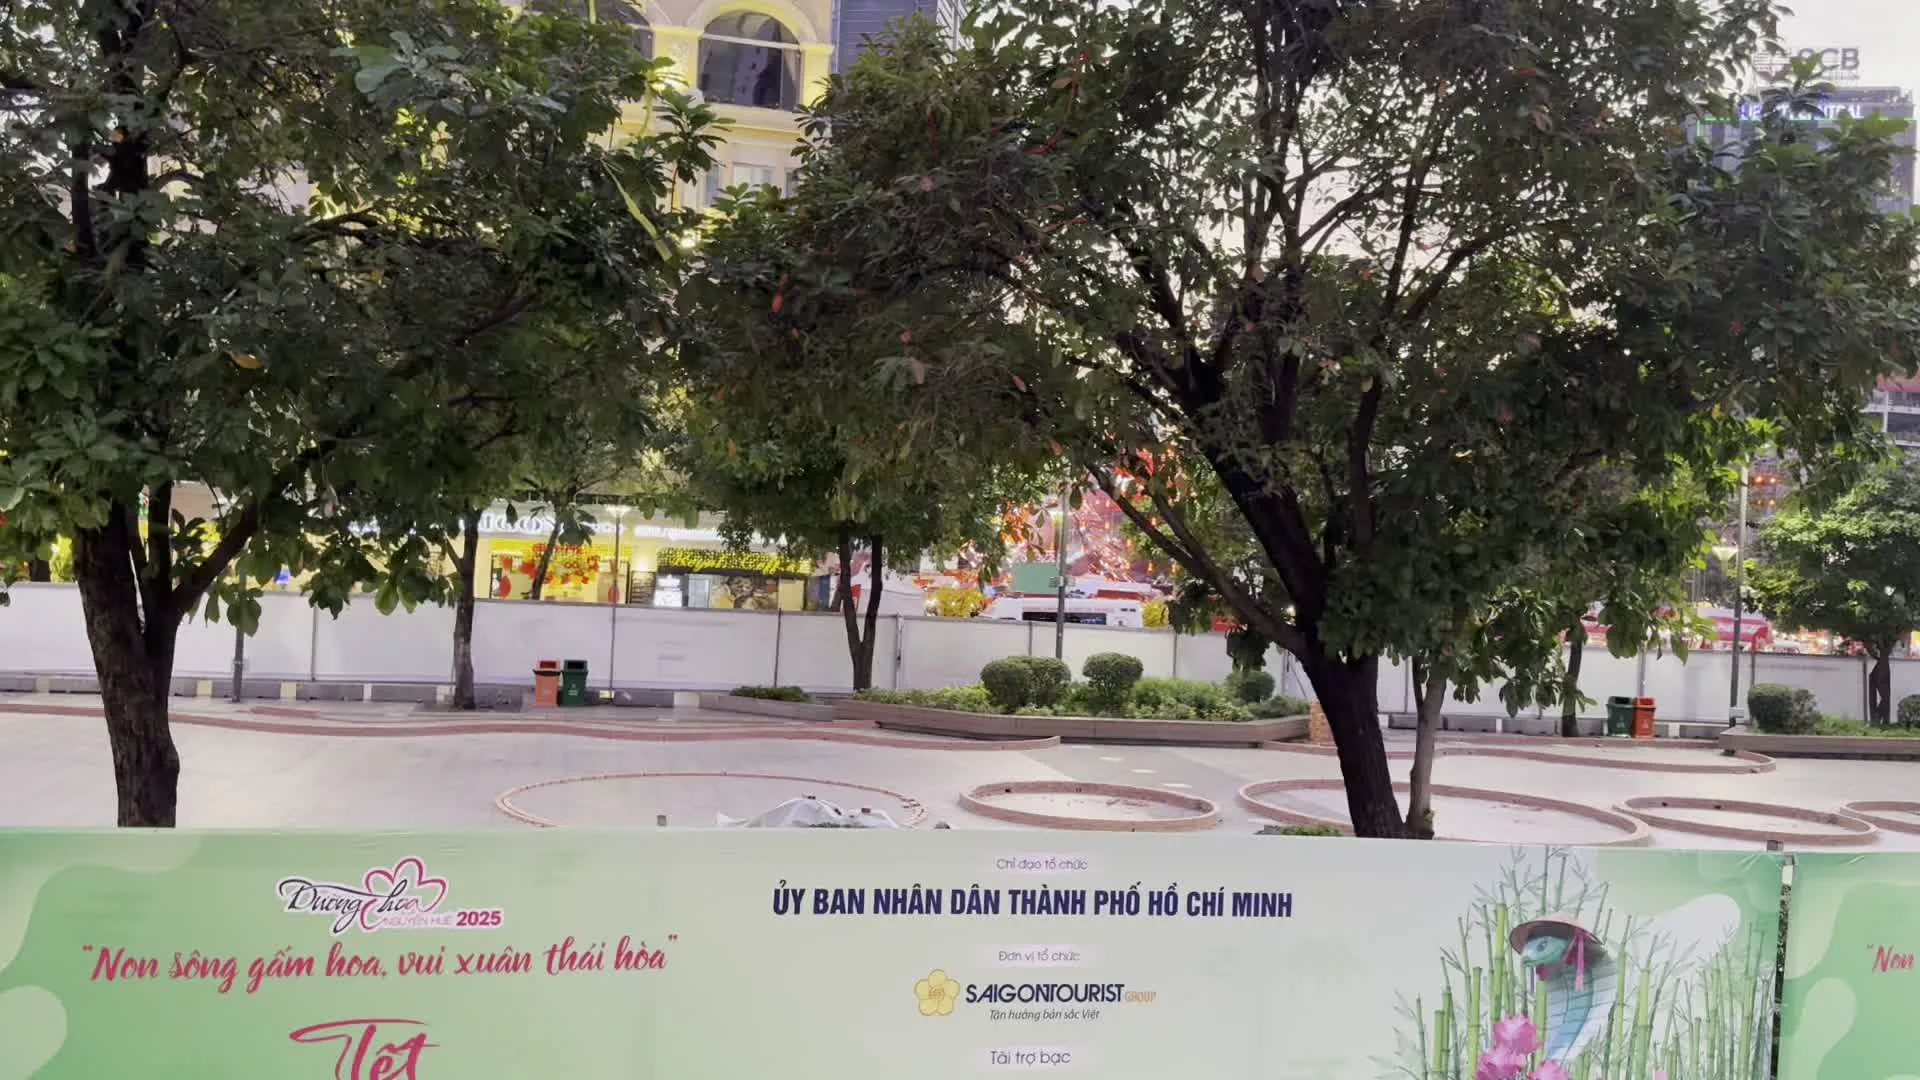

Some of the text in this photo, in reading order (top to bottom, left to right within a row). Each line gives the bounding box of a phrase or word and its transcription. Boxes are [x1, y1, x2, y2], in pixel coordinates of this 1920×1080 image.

[1018, 858, 1042, 871] đạo
[1044, 855, 1057, 870] tổ
[1059, 857, 1089, 870] chức
[773, 879, 1292, 918] ỦY BAN NHÂN DÂN THÀNH PHỐ HỒ CHÍ MINH
[456, 911, 502, 926] 2025
[168, 949, 239, 994] sông
[246, 945, 315, 994] gấm
[398, 945, 446, 976] vui
[454, 945, 533, 975] xuân
[544, 936, 607, 976] thái
[998, 950, 1022, 962] Đơn
[1051, 949, 1081, 962] chức
[965, 983, 1125, 1004] SAIGONTOURIST
[990, 1048, 1071, 1068] Tài trợ bạc
